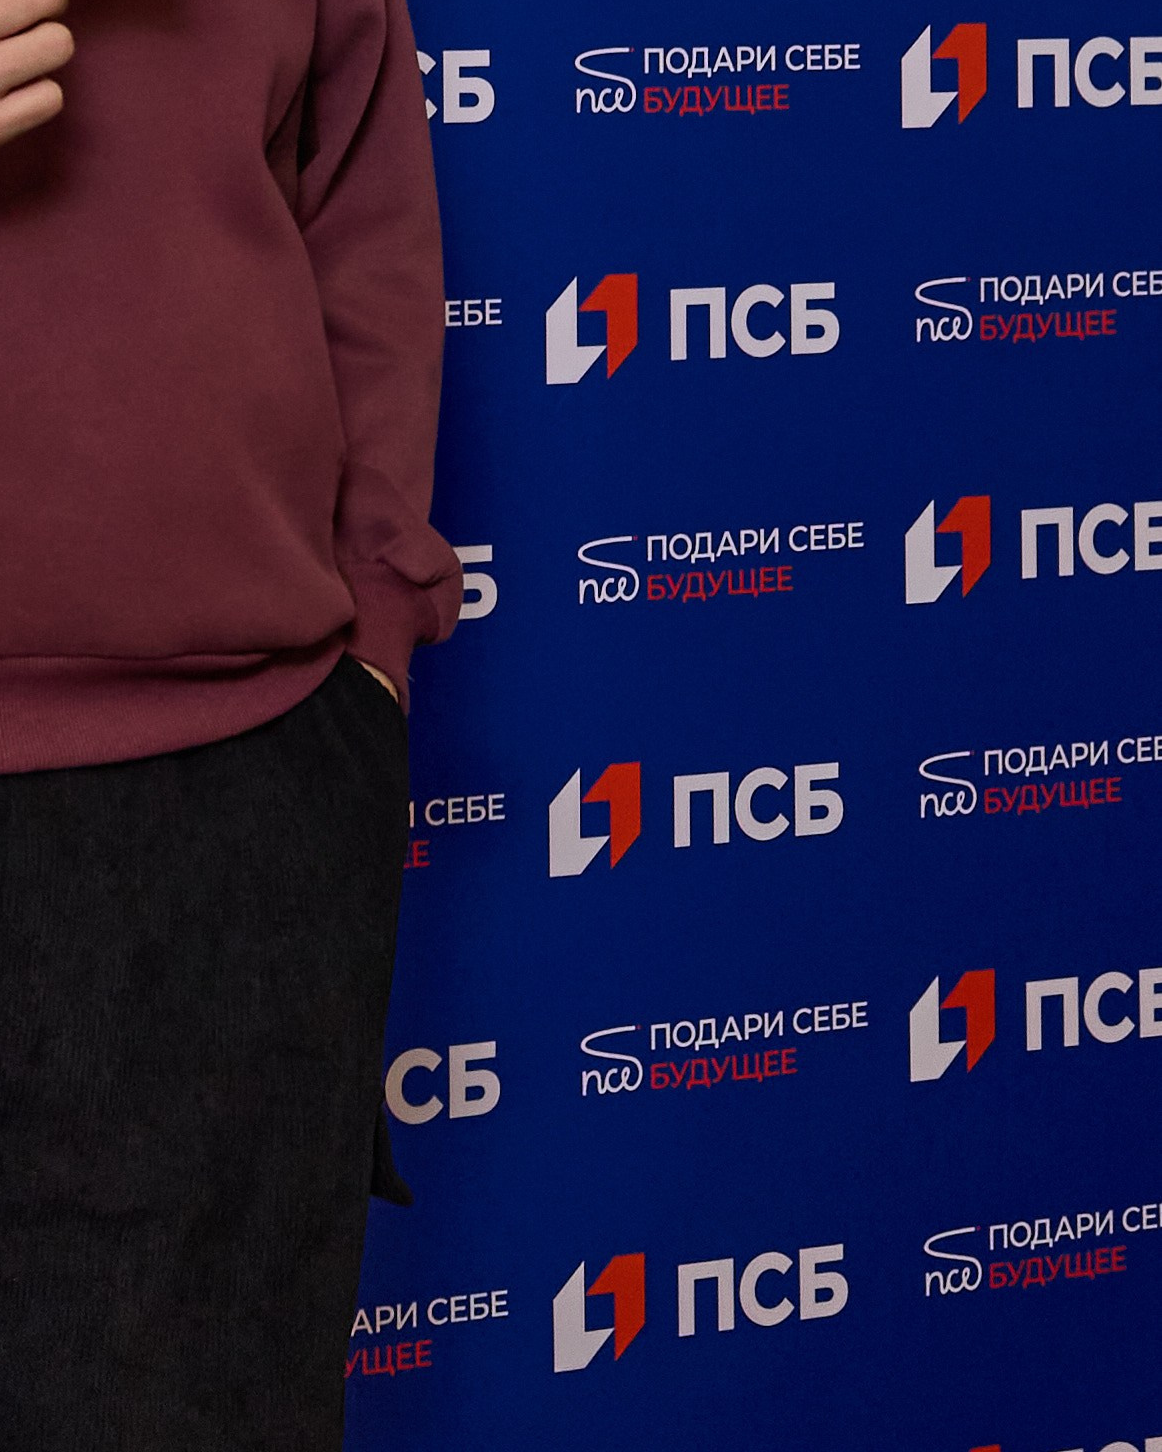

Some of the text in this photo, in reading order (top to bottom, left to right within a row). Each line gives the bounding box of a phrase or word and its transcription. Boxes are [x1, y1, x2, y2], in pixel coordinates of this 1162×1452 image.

[644, 44, 860, 78] ПОДАРИ СЕБЕ
[644, 84, 789, 116] БУДУЩЕЕ
[980, 270, 1162, 306] ПОДАРИ СЕБ
[445, 299, 502, 326] ЕБЕ
[670, 282, 839, 361] ПСБ
[980, 310, 1116, 342] БУДУЩЕЕ
[647, 522, 864, 564] ПОДАРИ СЕБЕ
[648, 566, 793, 602] БУДУЩЕЕ
[985, 740, 1108, 777] ПОДАРИ
[425, 794, 505, 825] СЕБЕ
[674, 762, 843, 848] ПСБ
[984, 778, 1121, 814] БУДУЩЕЕ
[651, 1001, 868, 1051] ПОДАРИ СЕБЕ
[385, 1041, 500, 1124] СБ
[651, 1048, 797, 1089] БУДУЩЕЕ
[990, 1210, 1113, 1250] ПОДАРИ
[990, 1246, 1126, 1288] БУДУЩЕЕ
[678, 1244, 848, 1337] ПСБ
[351, 1290, 508, 1337] АРИ СЕБЕ
[346, 1340, 432, 1377] УЩЕЕ
